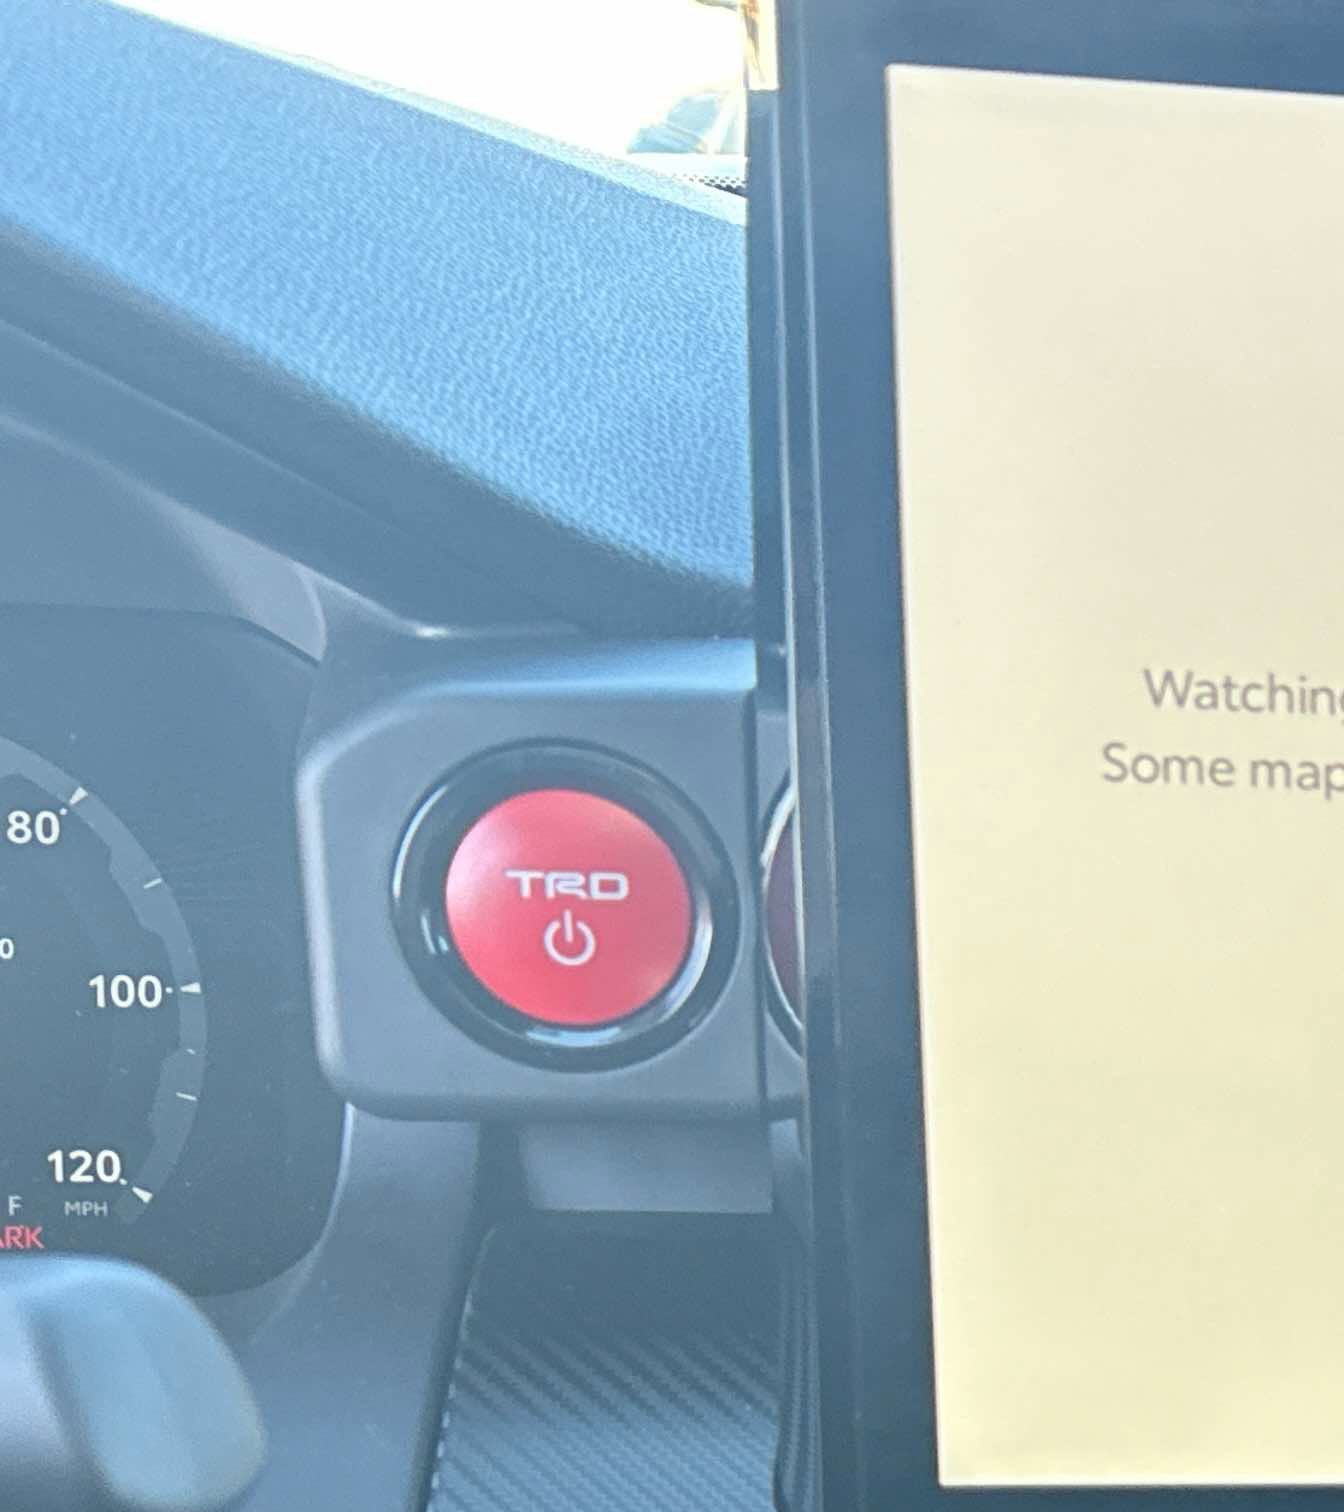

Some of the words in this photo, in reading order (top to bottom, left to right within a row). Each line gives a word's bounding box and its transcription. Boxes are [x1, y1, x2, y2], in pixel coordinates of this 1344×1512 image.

[1102, 742, 1236, 787] Some
[6, 810, 60, 845] 80
[504, 869, 630, 901] TRD
[88, 974, 163, 1009] 100
[47, 1149, 122, 1183] 120
[64, 1200, 109, 1217] MPH
[0, 1225, 44, 1248] RK
